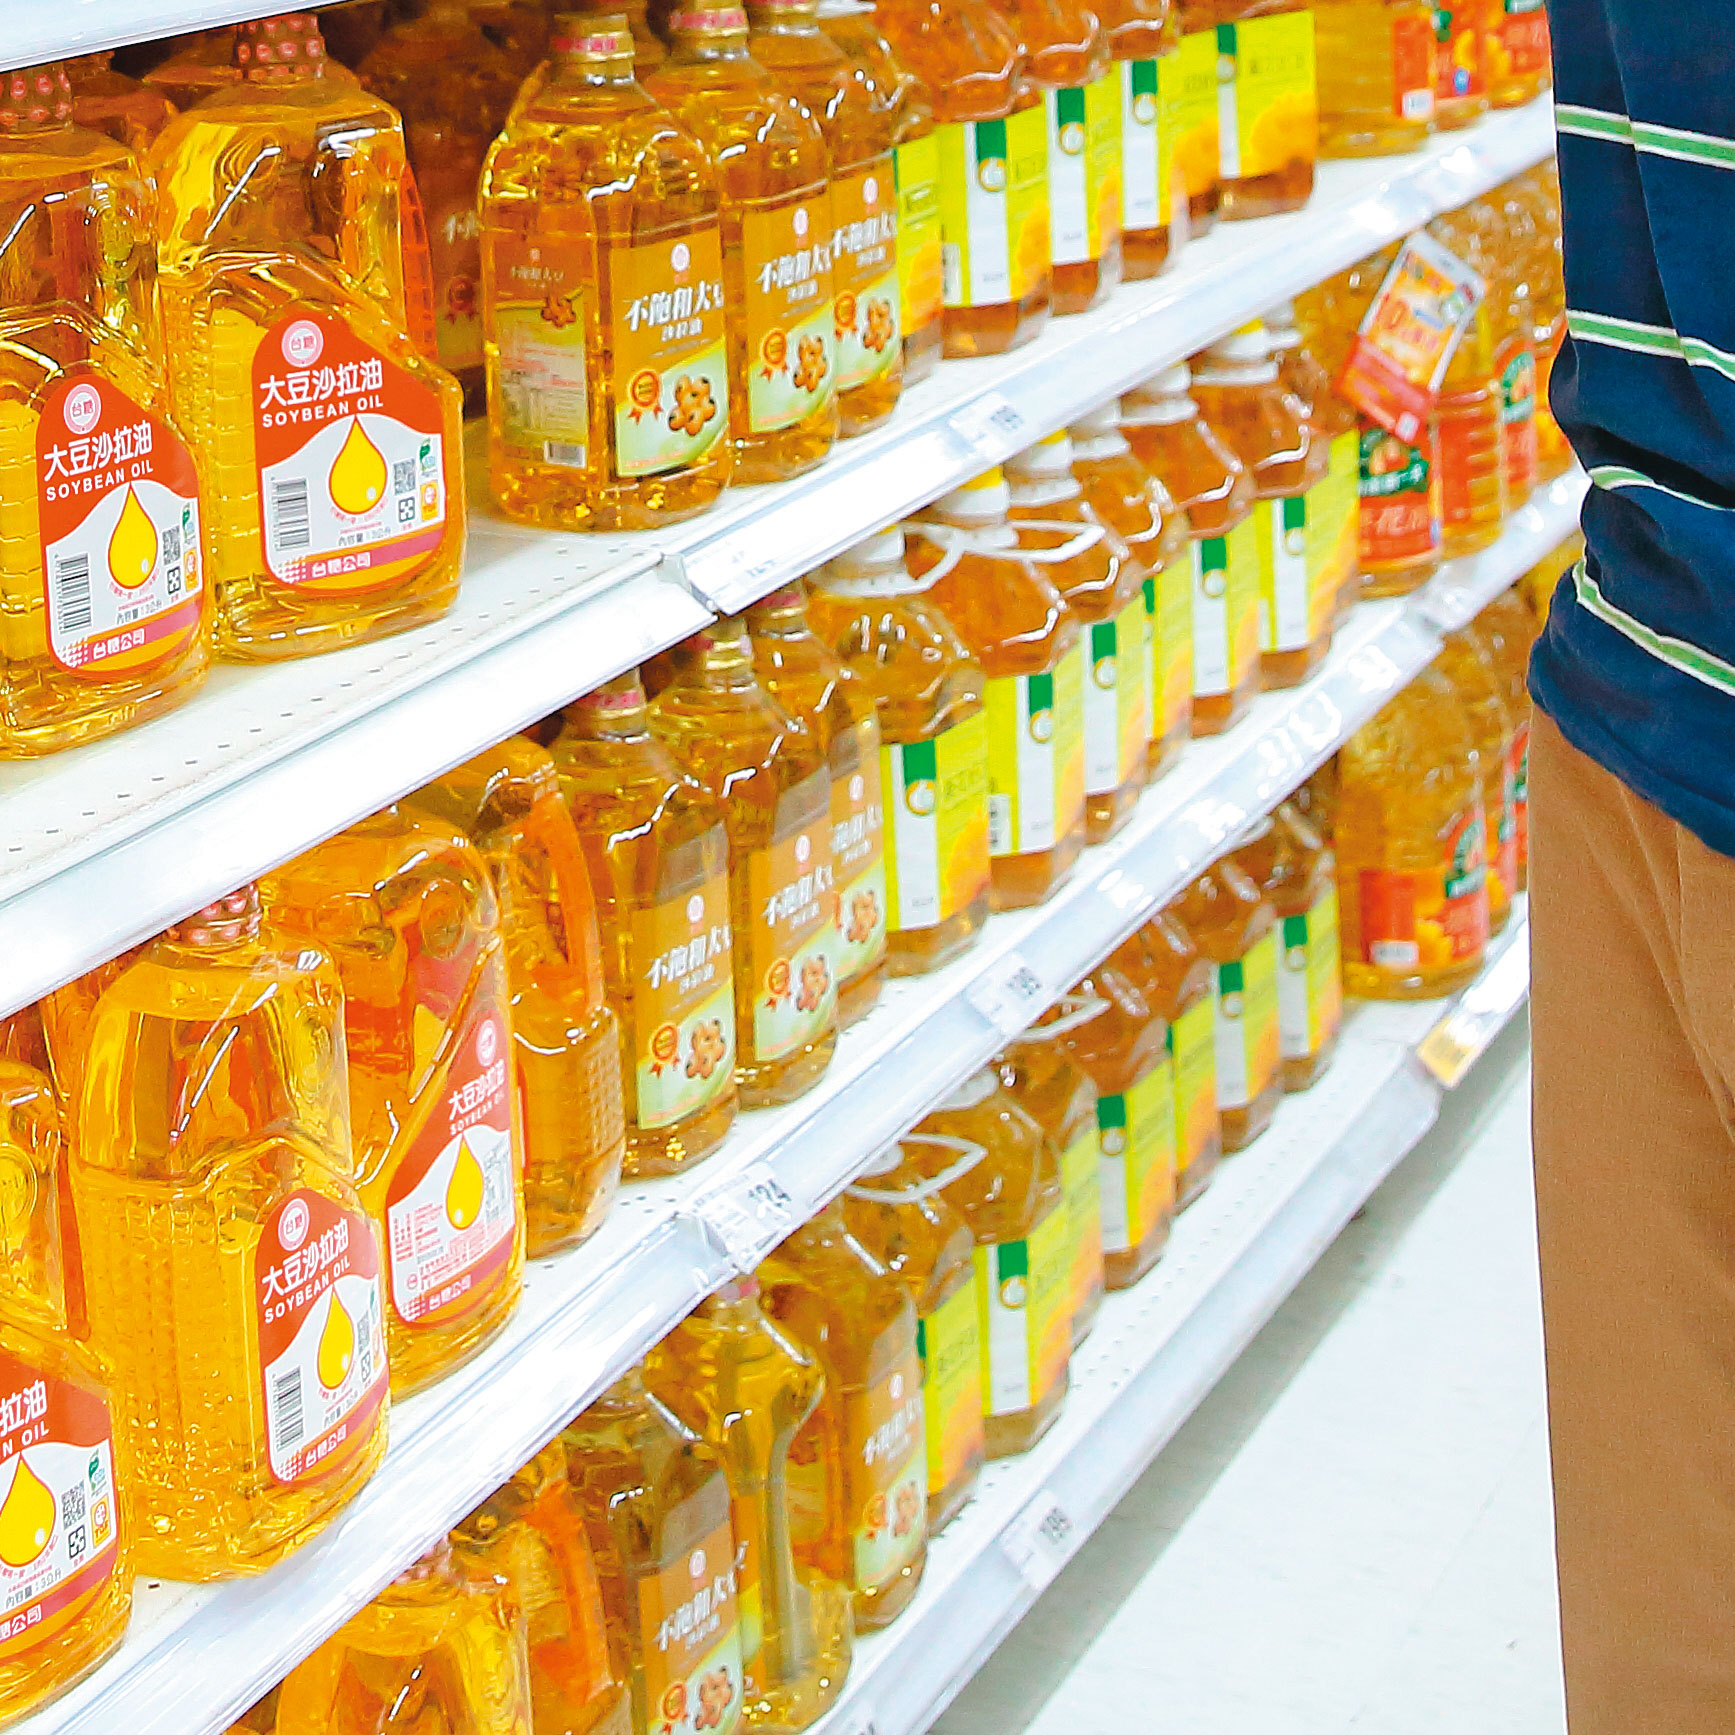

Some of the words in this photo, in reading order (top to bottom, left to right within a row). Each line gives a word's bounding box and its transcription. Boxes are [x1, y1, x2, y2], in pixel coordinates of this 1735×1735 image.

[260, 357, 384, 409] 大豆沙拉油
[262, 401, 349, 429] SOYBEAN
[356, 396, 384, 413] OIL
[43, 419, 153, 483] 大豆沙拉油
[45, 466, 125, 502] SOYBEAN
[131, 459, 154, 478] OIL
[262, 1217, 350, 1306] 大豆沙拉油
[265, 1271, 330, 1324] SOYBEAN
[333, 1255, 351, 1280] OIL
[21, 1420, 50, 1446] OIL
